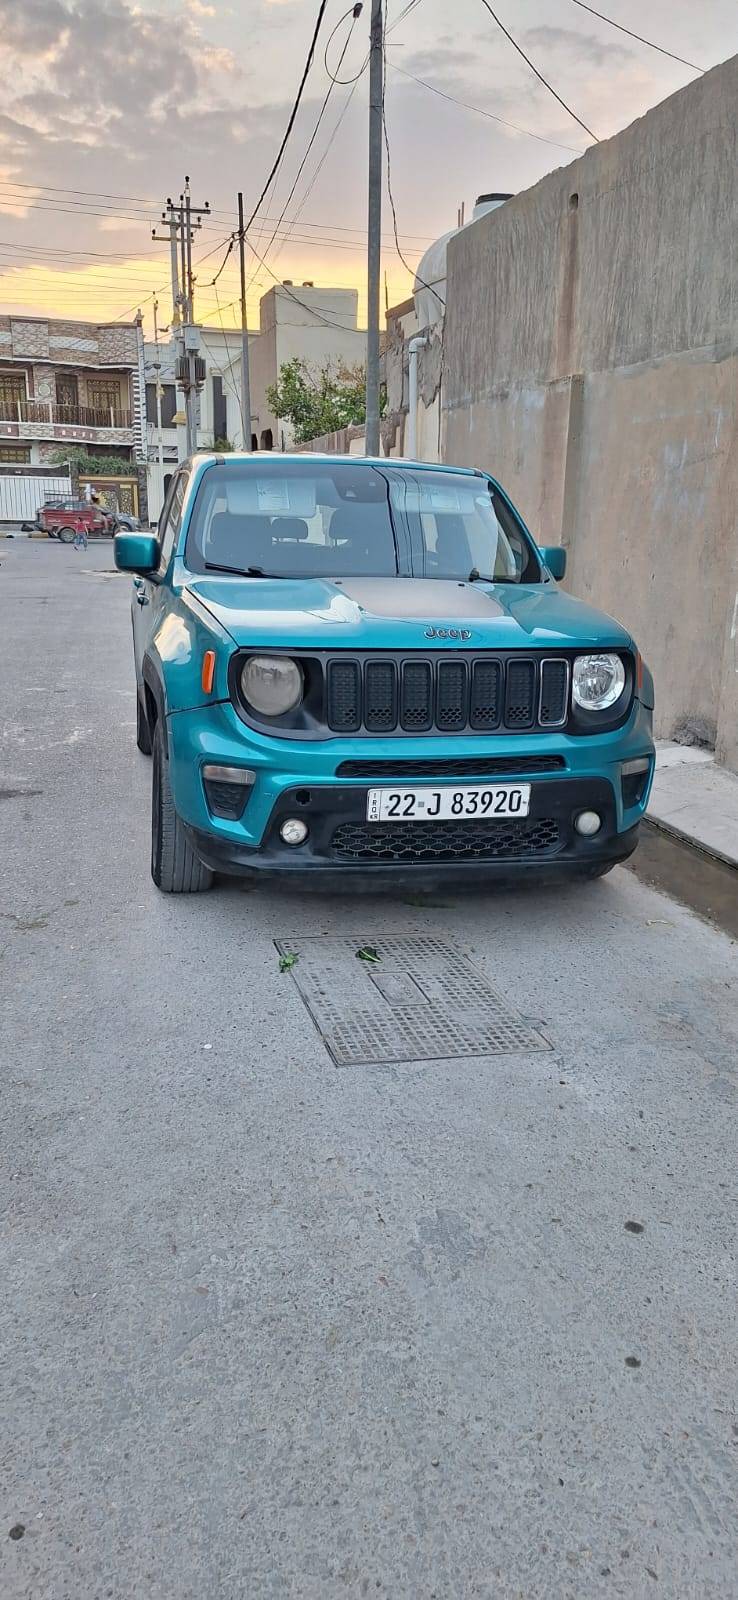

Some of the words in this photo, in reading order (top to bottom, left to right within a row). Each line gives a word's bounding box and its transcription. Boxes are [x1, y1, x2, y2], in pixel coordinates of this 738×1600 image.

[424, 625, 472, 642] Jeep
[387, 794, 416, 817] 22
[427, 793, 441, 816] J
[451, 790, 522, 815] 83920
